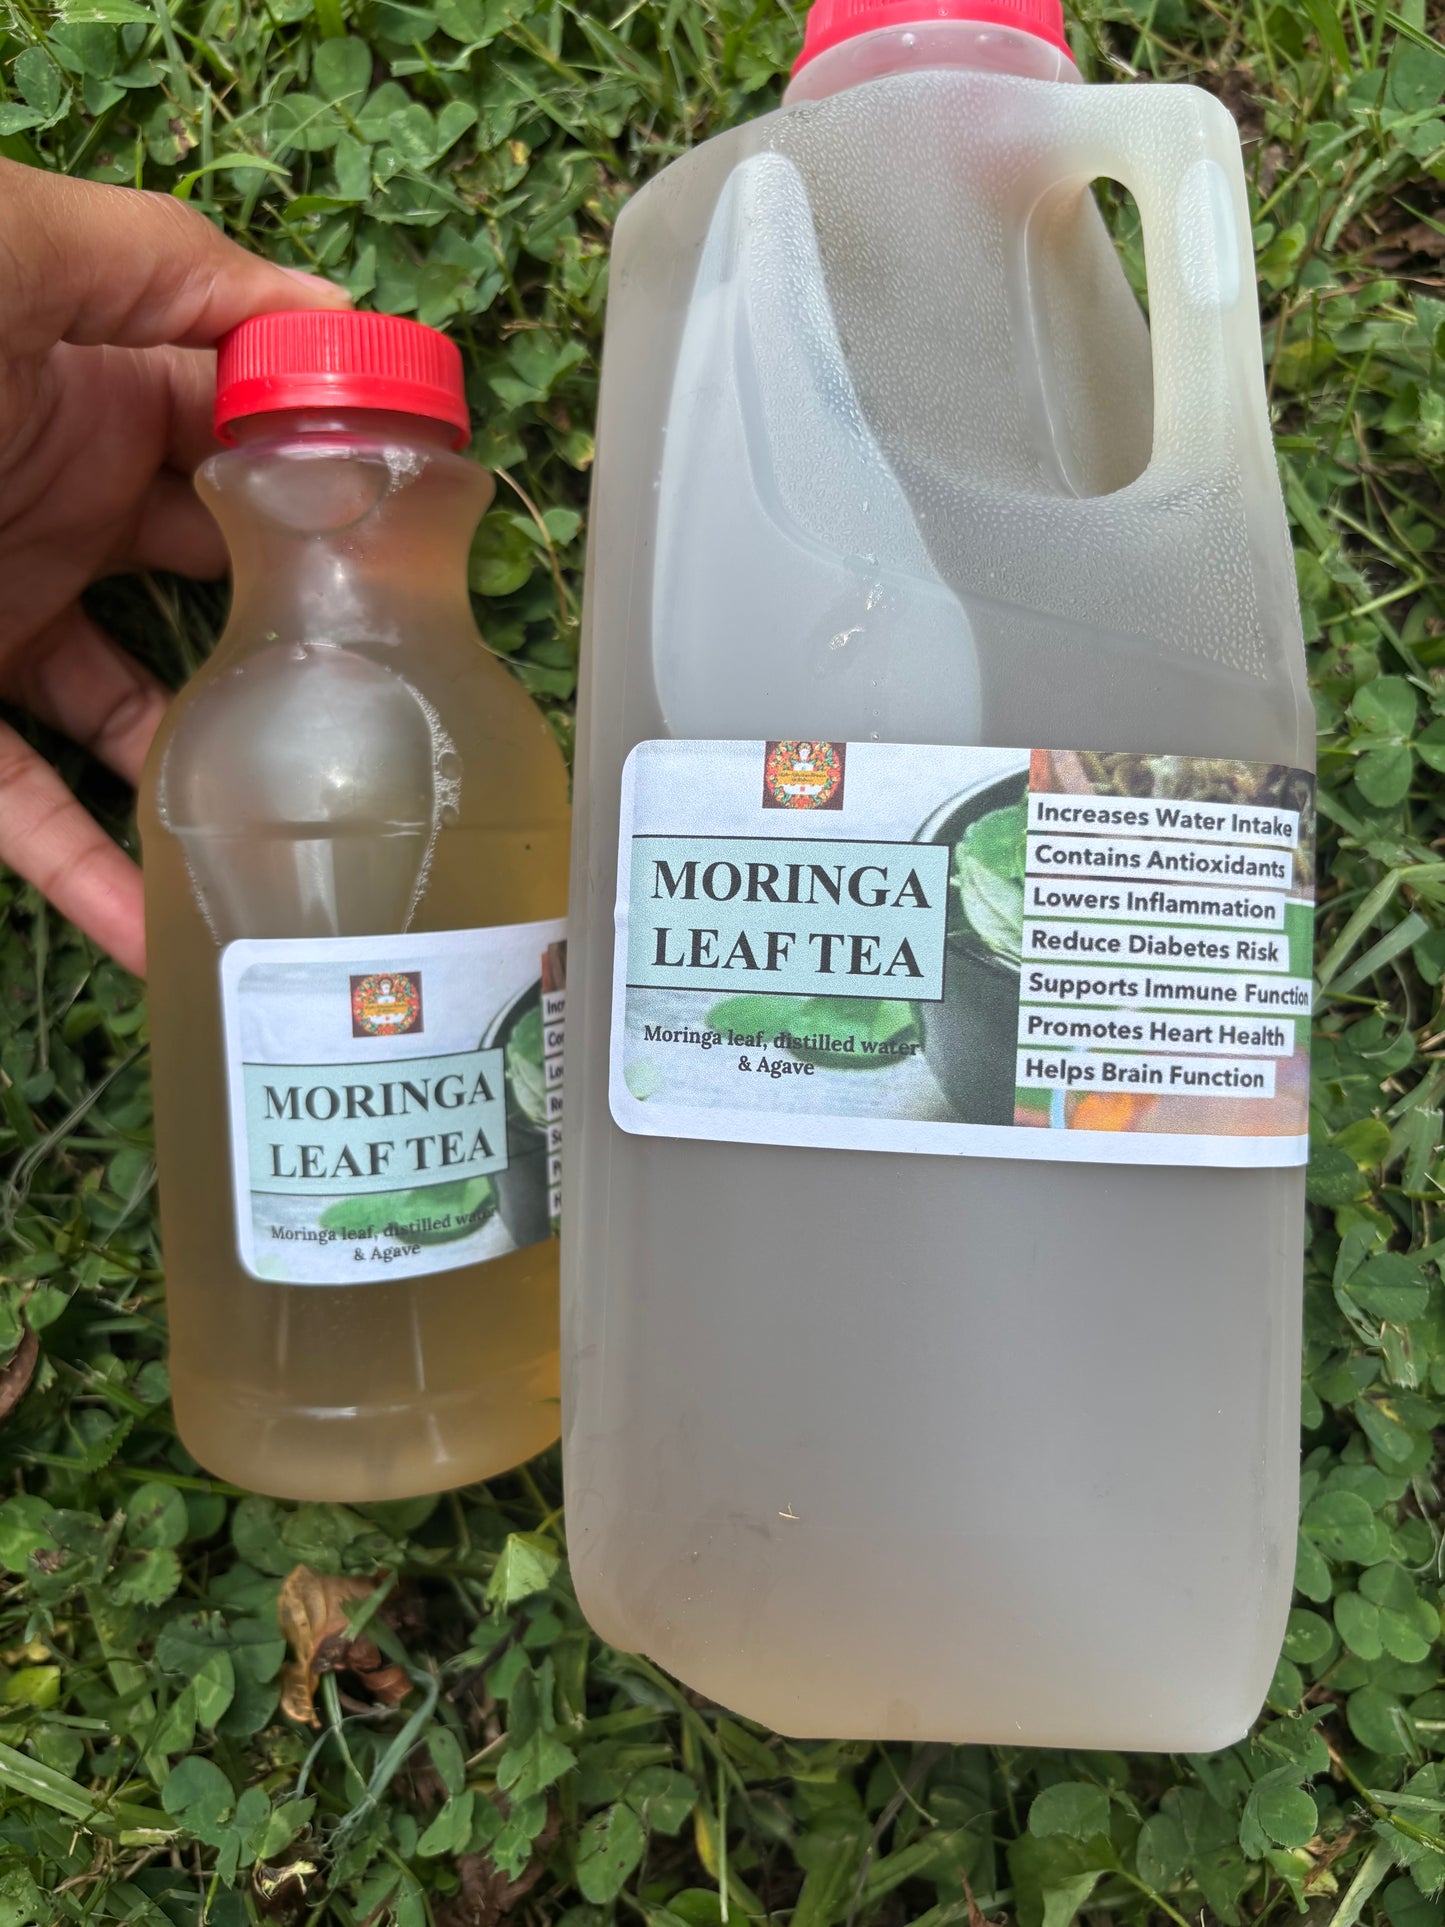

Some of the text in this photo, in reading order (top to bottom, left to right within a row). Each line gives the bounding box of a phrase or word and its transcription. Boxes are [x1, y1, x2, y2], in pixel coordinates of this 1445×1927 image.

[1037, 802, 1292, 837] Increases Water Intake
[1035, 844, 1285, 878] Contains Antioxidants
[651, 860, 932, 908] MORINGA
[1033, 887, 1276, 919] Lowers Inflammation
[651, 927, 924, 978] LEAF TEA
[1031, 930, 1278, 962] Reduce Diabetes Risk
[1029, 973, 1308, 1007] Supports Immune Function
[644, 1025, 920, 1056] Moringa leaf, distilled water
[1027, 1016, 1285, 1047] Promotes Heart Health
[738, 1056, 814, 1080] & Agave
[1026, 1059, 1264, 1088] Helps Brain Function
[264, 1070, 496, 1121] MORINGA
[269, 1128, 495, 1178] LEAF TEA
[271, 1206, 496, 1246] Moringa leaf, distilled water
[353, 1242, 421, 1263] & Agave
